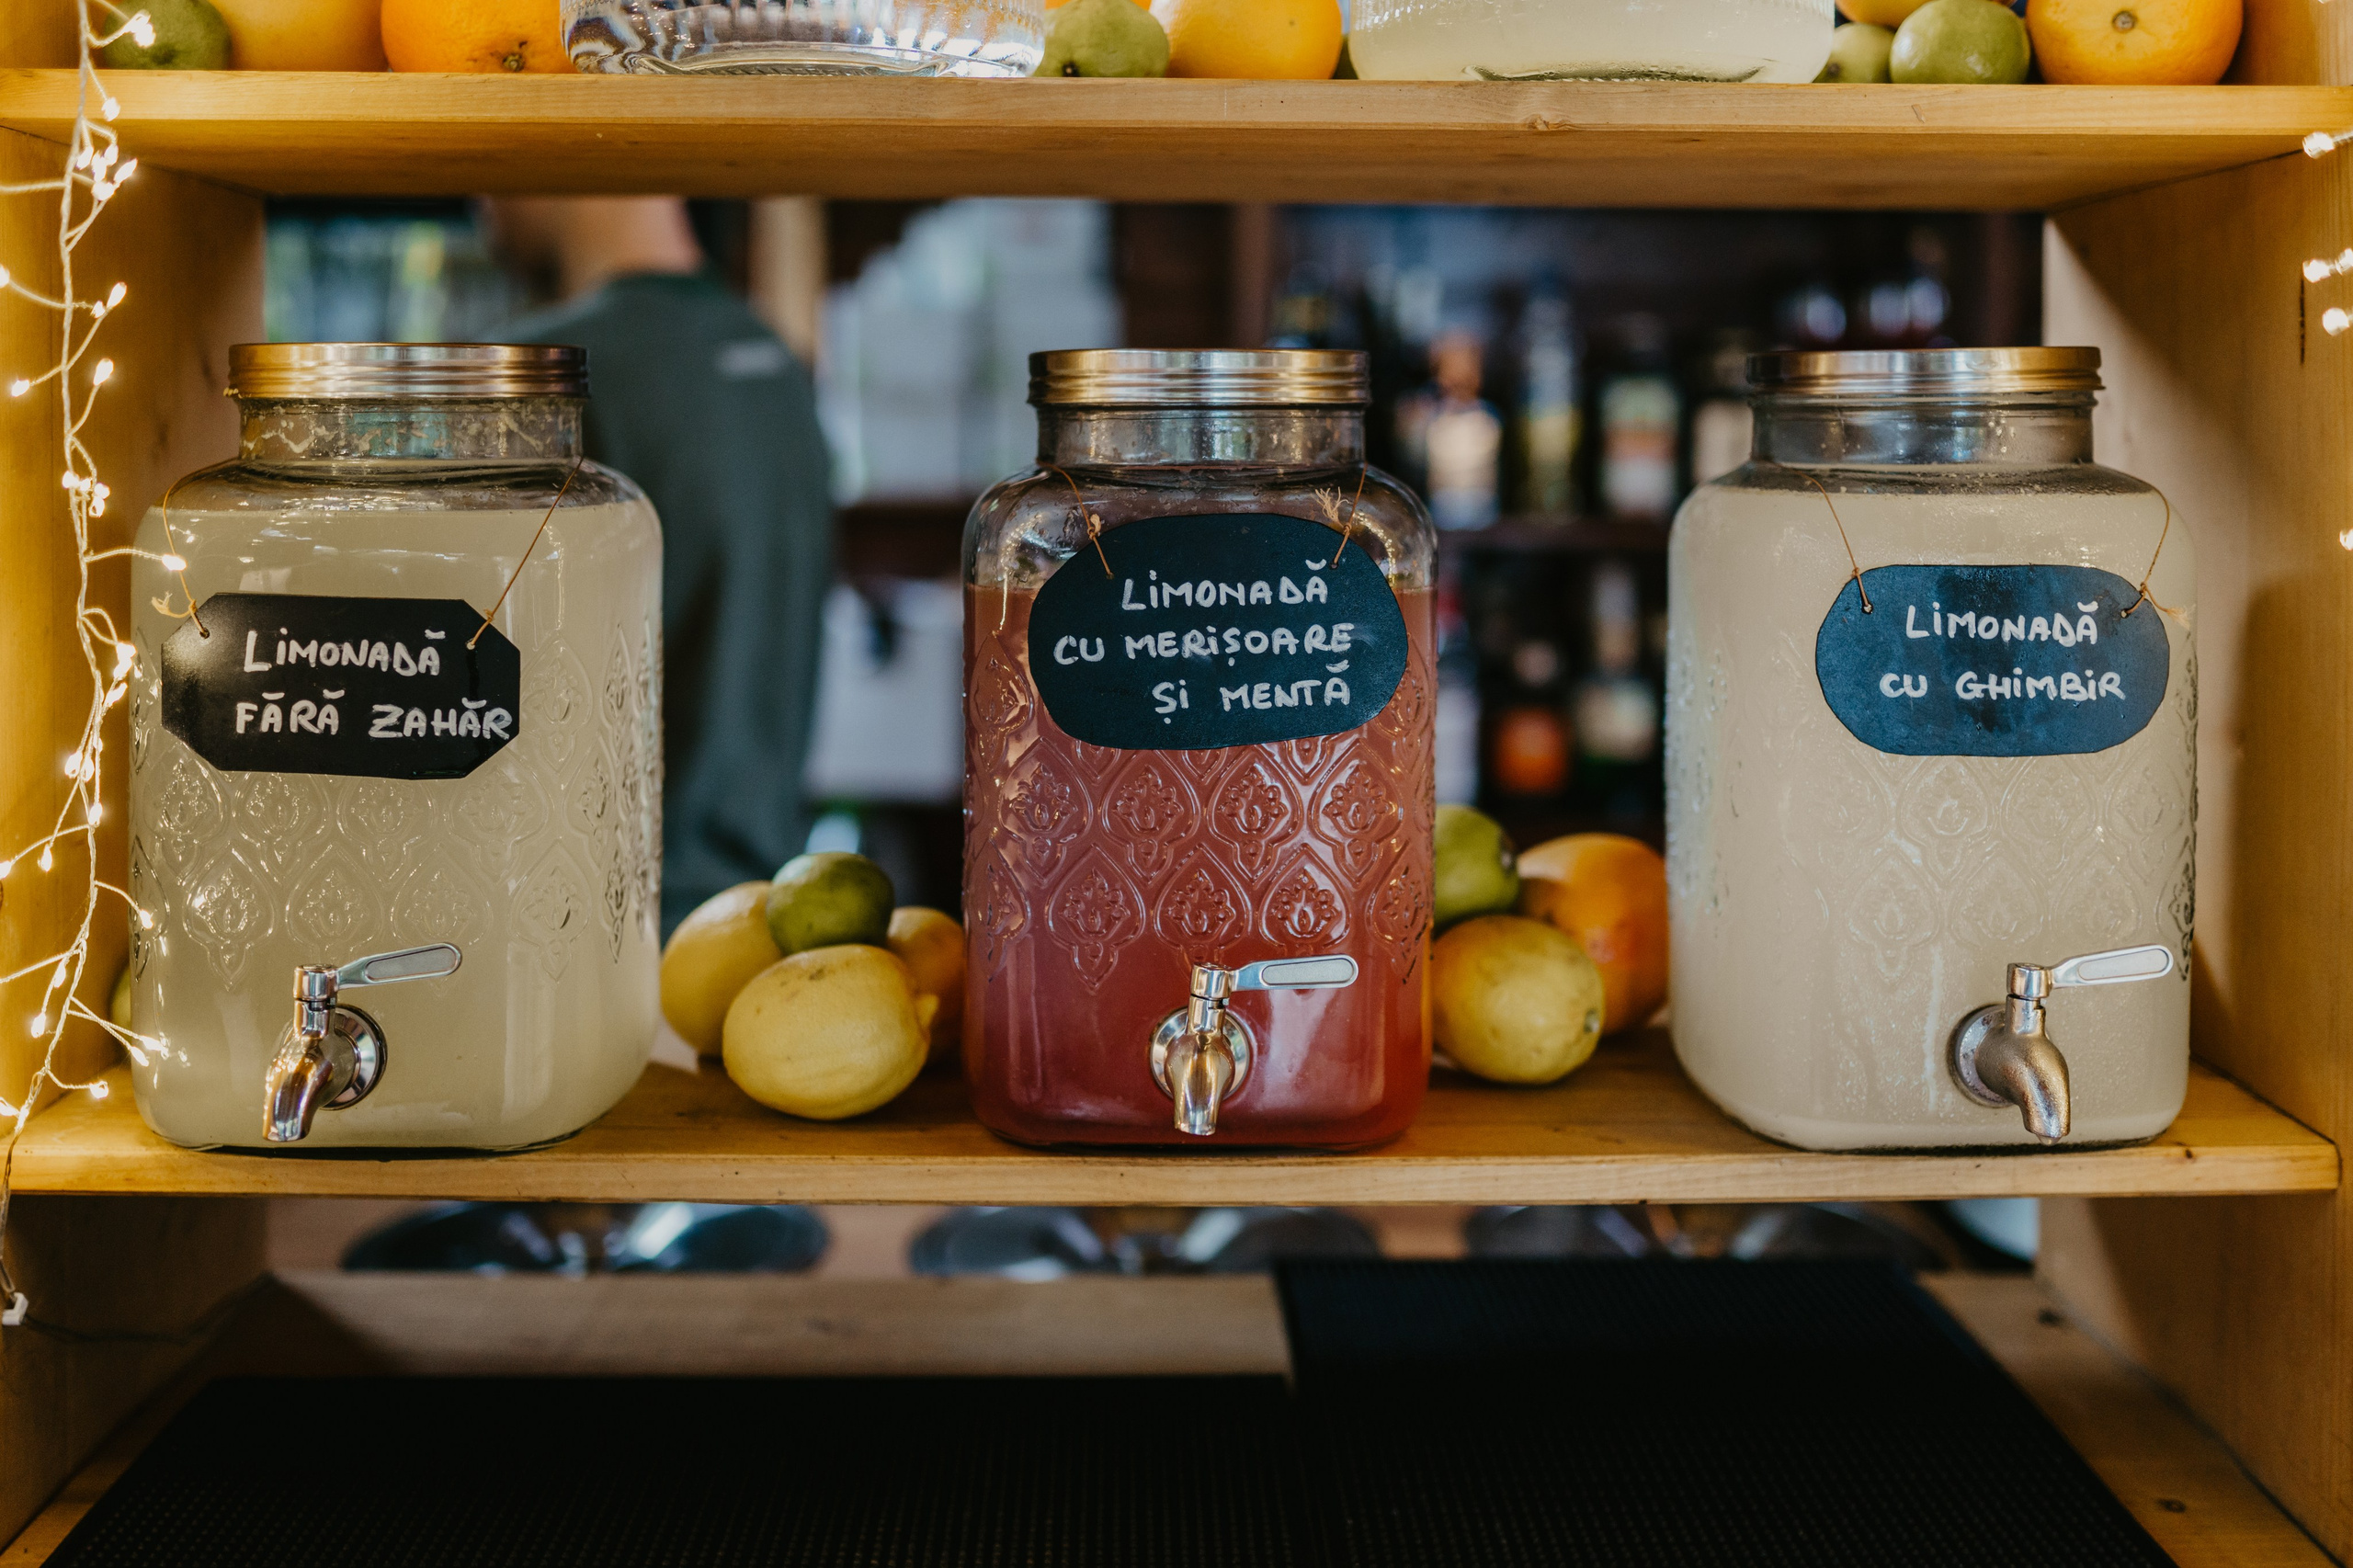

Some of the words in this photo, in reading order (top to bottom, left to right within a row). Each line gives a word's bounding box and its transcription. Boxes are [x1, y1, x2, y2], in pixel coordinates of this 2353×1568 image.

[1053, 635, 1104, 665] CU
[1220, 659, 1351, 712] MENTĂ
[1880, 672, 1928, 699] CU
[235, 689, 345, 736] FĂRĂ
[368, 697, 513, 740] ZAHĂR
